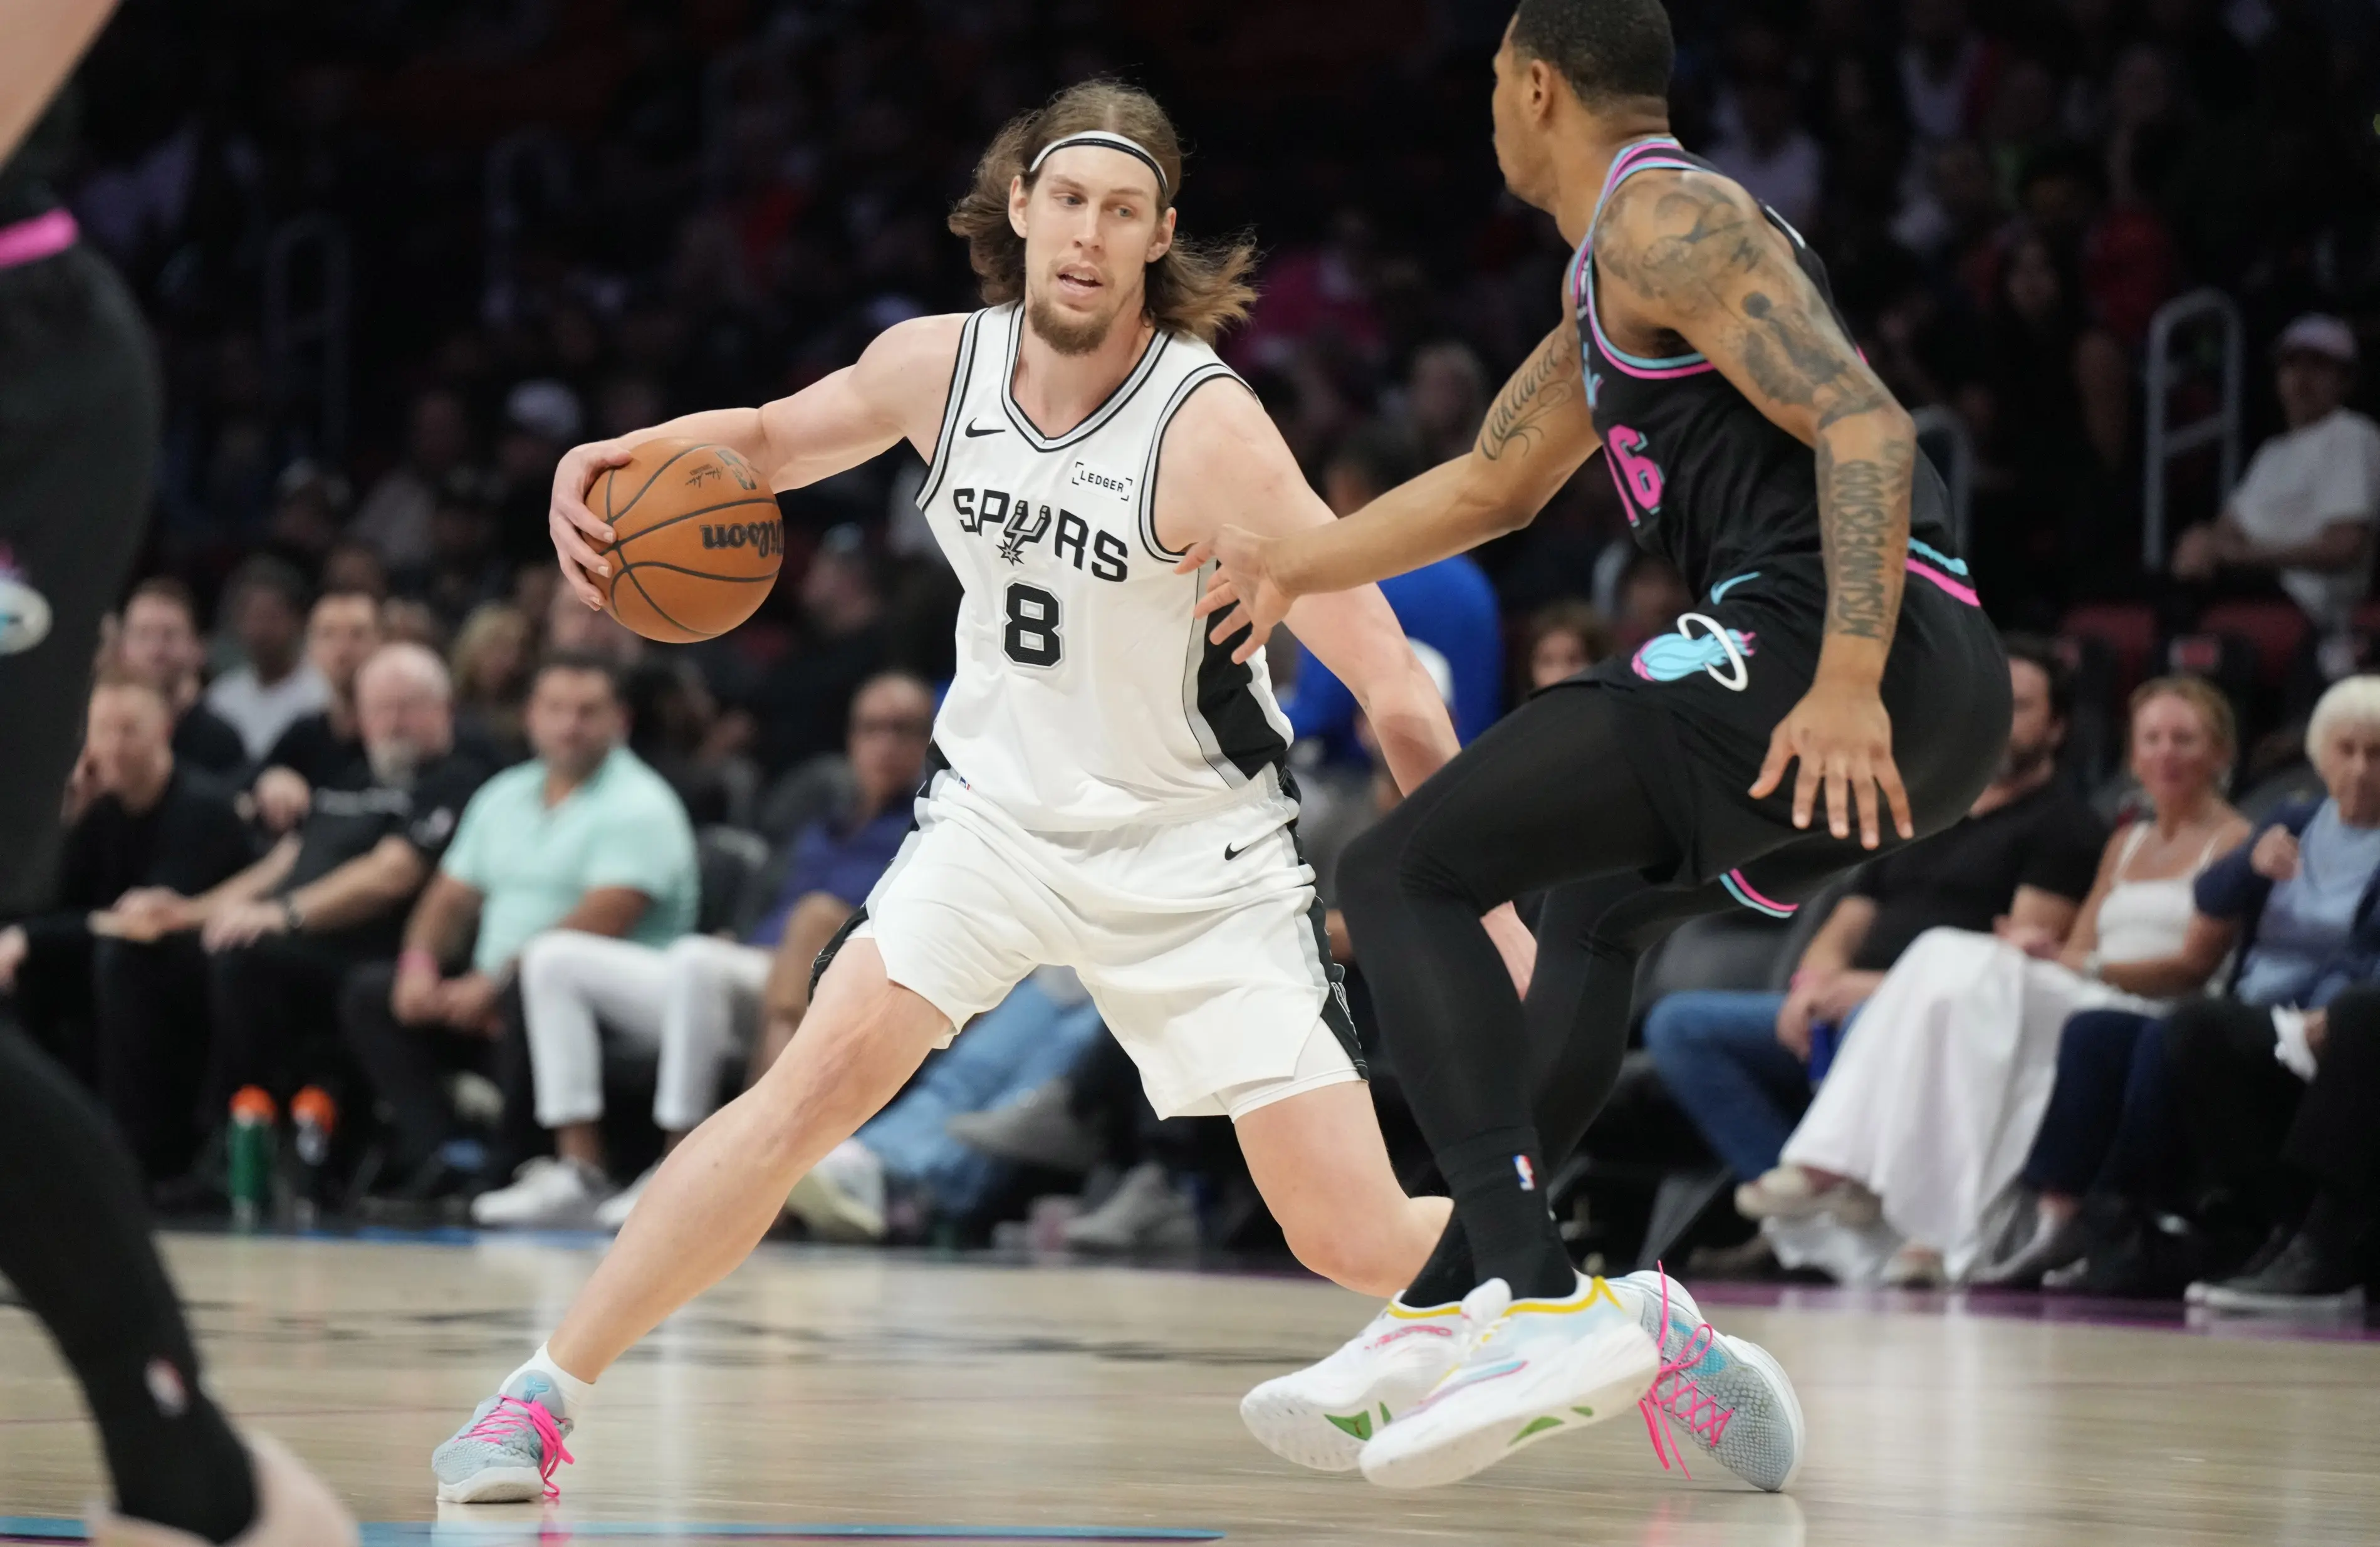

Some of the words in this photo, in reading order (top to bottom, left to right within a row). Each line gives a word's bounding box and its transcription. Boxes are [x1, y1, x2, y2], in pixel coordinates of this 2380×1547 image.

[1080, 470, 1124, 493] LEDGER
[953, 488, 1128, 582] SPURS
[1002, 580, 1063, 669] 8
